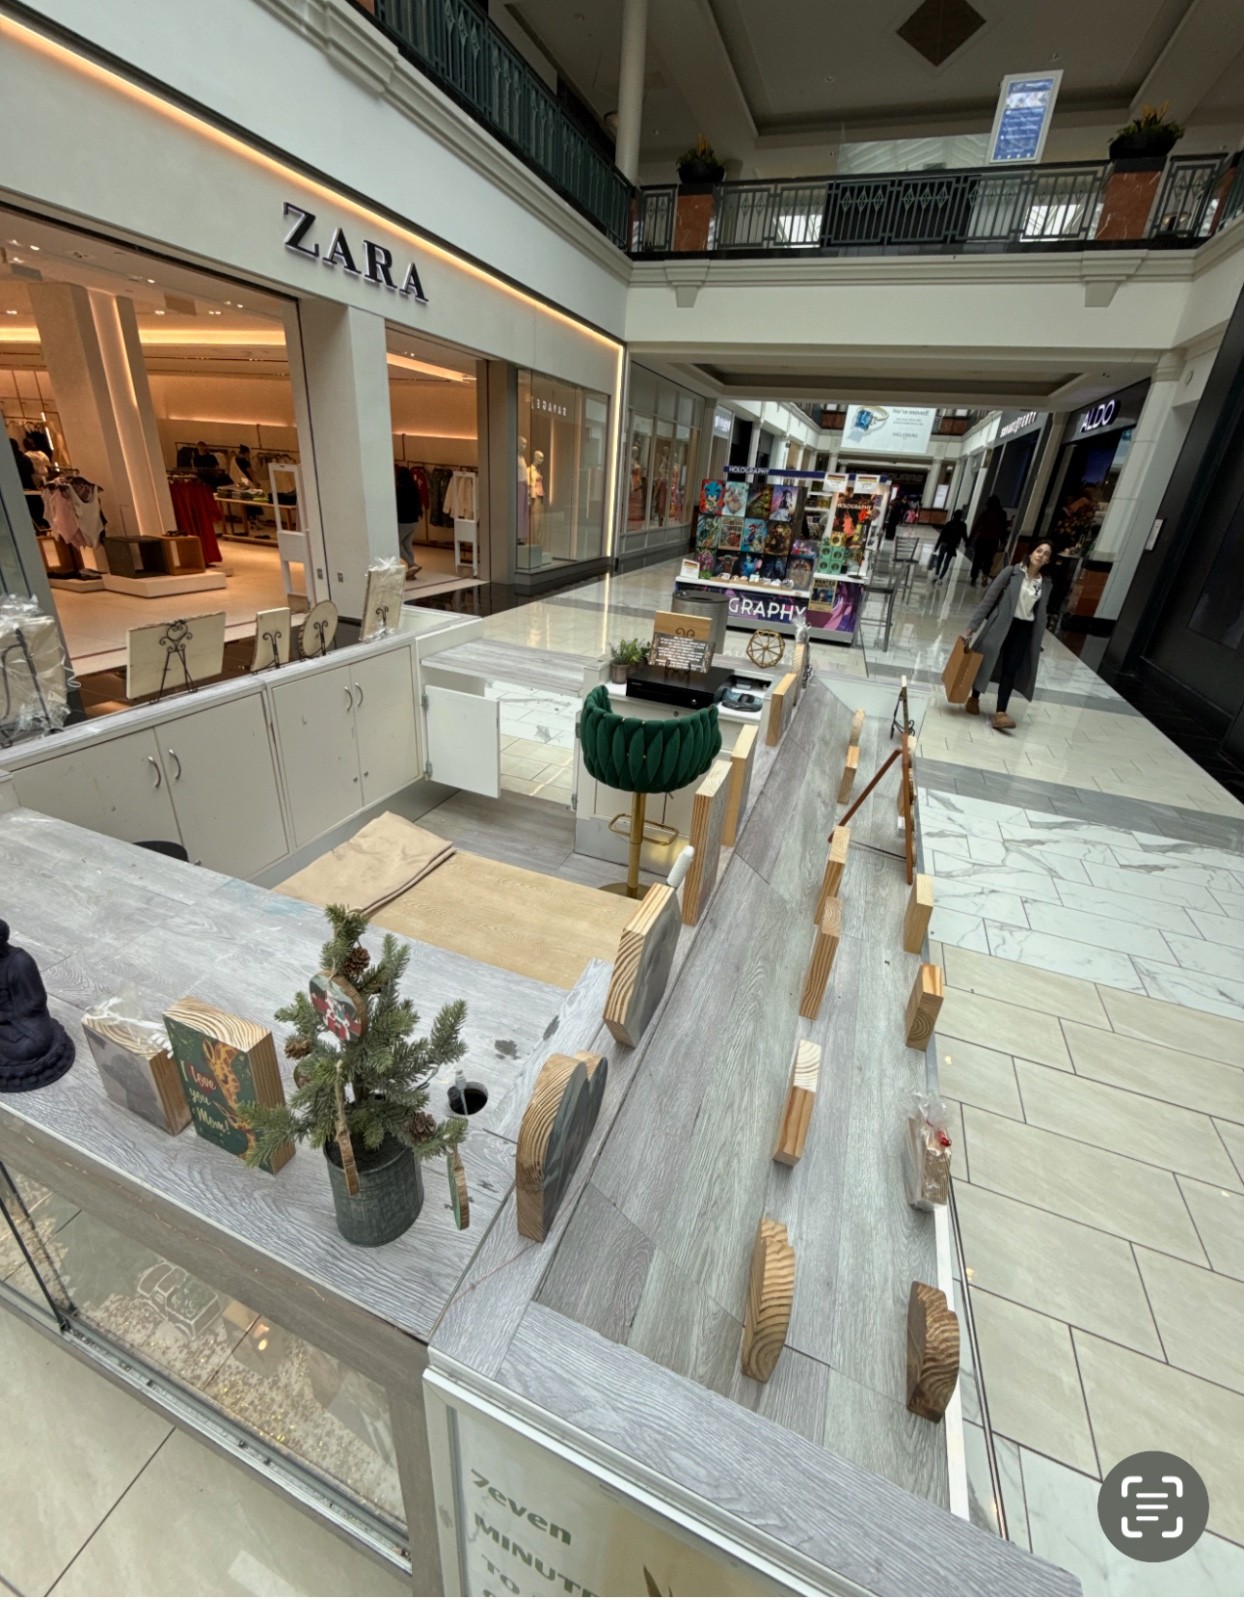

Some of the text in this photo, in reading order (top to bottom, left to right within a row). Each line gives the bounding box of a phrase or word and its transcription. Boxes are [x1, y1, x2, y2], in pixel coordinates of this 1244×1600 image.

[282, 201, 430, 304] ZARA
[1080, 399, 1116, 433] ALDO
[728, 465, 769, 475] HOLOGRAPHY
[181, 1060, 217, 1091] I love
[189, 1087, 211, 1106] you
[192, 1106, 231, 1135] Mom!
[481, 1554, 521, 1595] TO
